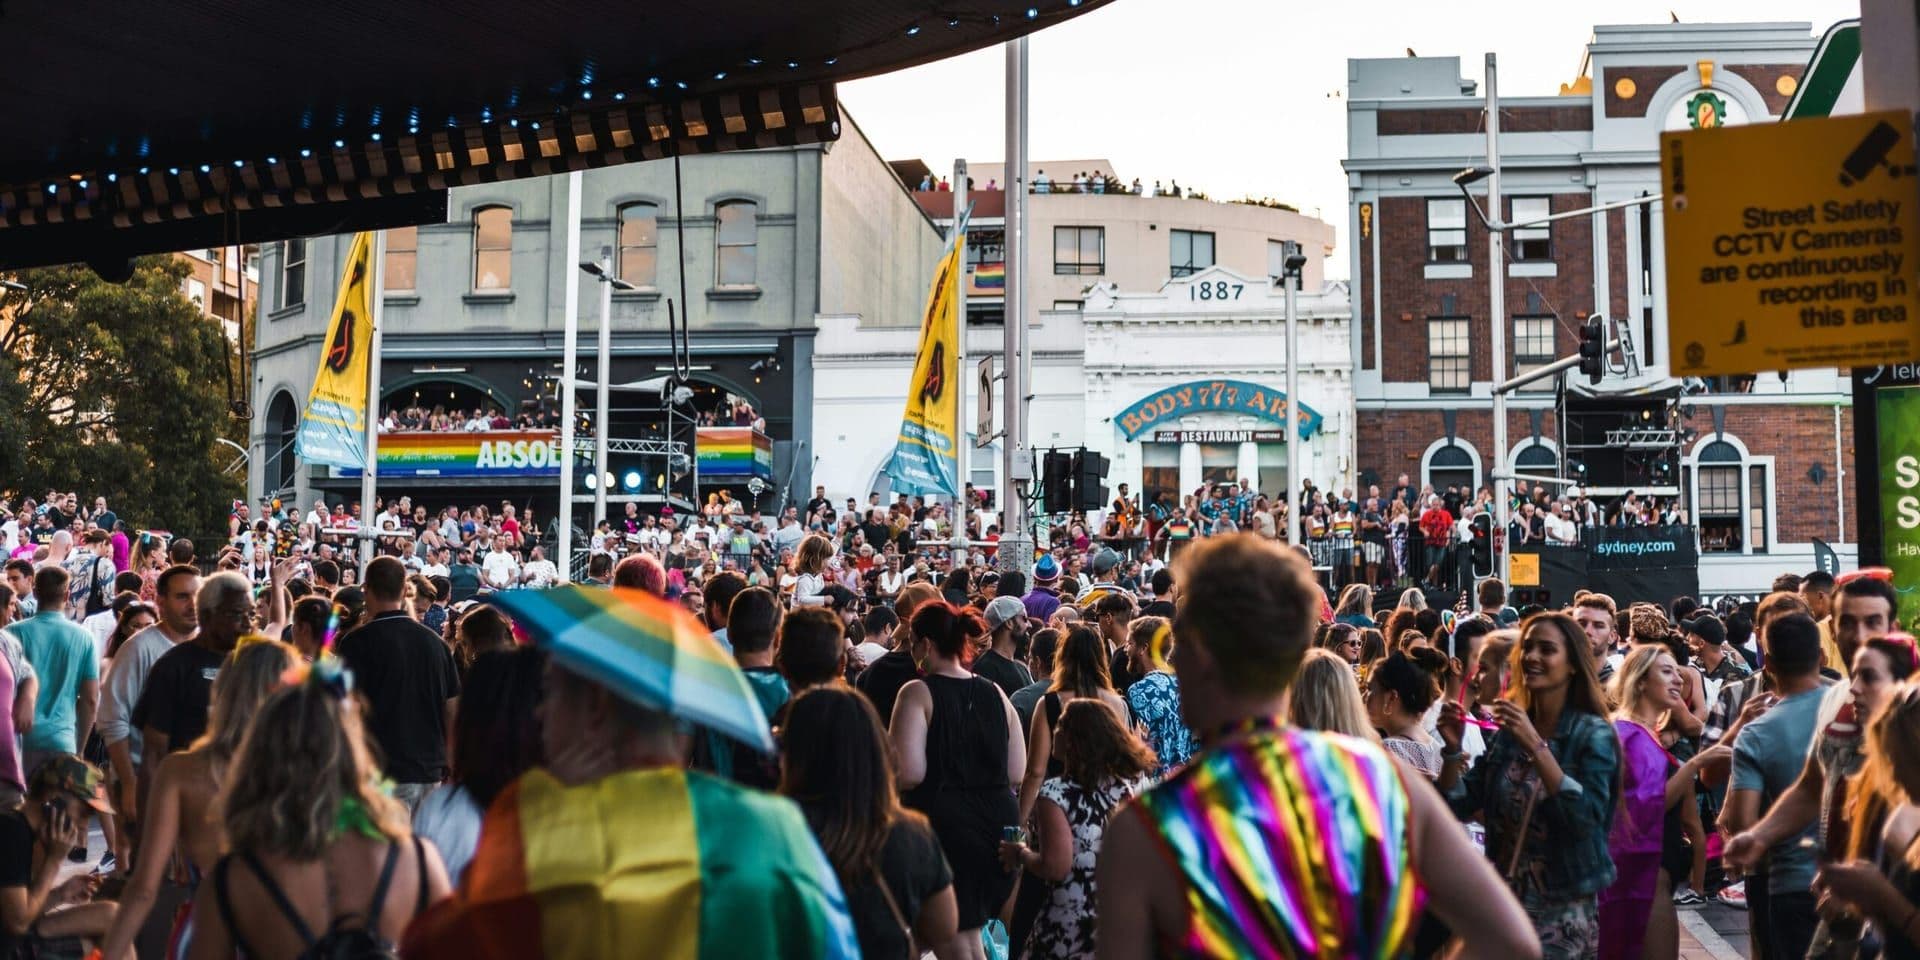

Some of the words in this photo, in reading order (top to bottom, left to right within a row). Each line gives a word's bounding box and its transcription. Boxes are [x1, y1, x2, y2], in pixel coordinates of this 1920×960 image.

[1743, 204, 1815, 228] Street
[1824, 199, 1901, 223] Safety
[1713, 232, 1786, 257] CCTV
[1792, 225, 1903, 250] Cameras
[1700, 264, 1739, 284] are
[1747, 250, 1904, 280] continuously
[1190, 281, 1244, 301] 1887
[1760, 280, 1877, 305] recording
[1884, 276, 1906, 296] in
[1800, 306, 1845, 328] this
[1854, 304, 1907, 324] area
[1121, 388, 1193, 434] BODY
[1198, 382, 1239, 406] 777
[1180, 431, 1253, 443] RESTAURANT
[476, 441, 560, 468] ABSOL
[1597, 540, 1675, 556] sydney.com
